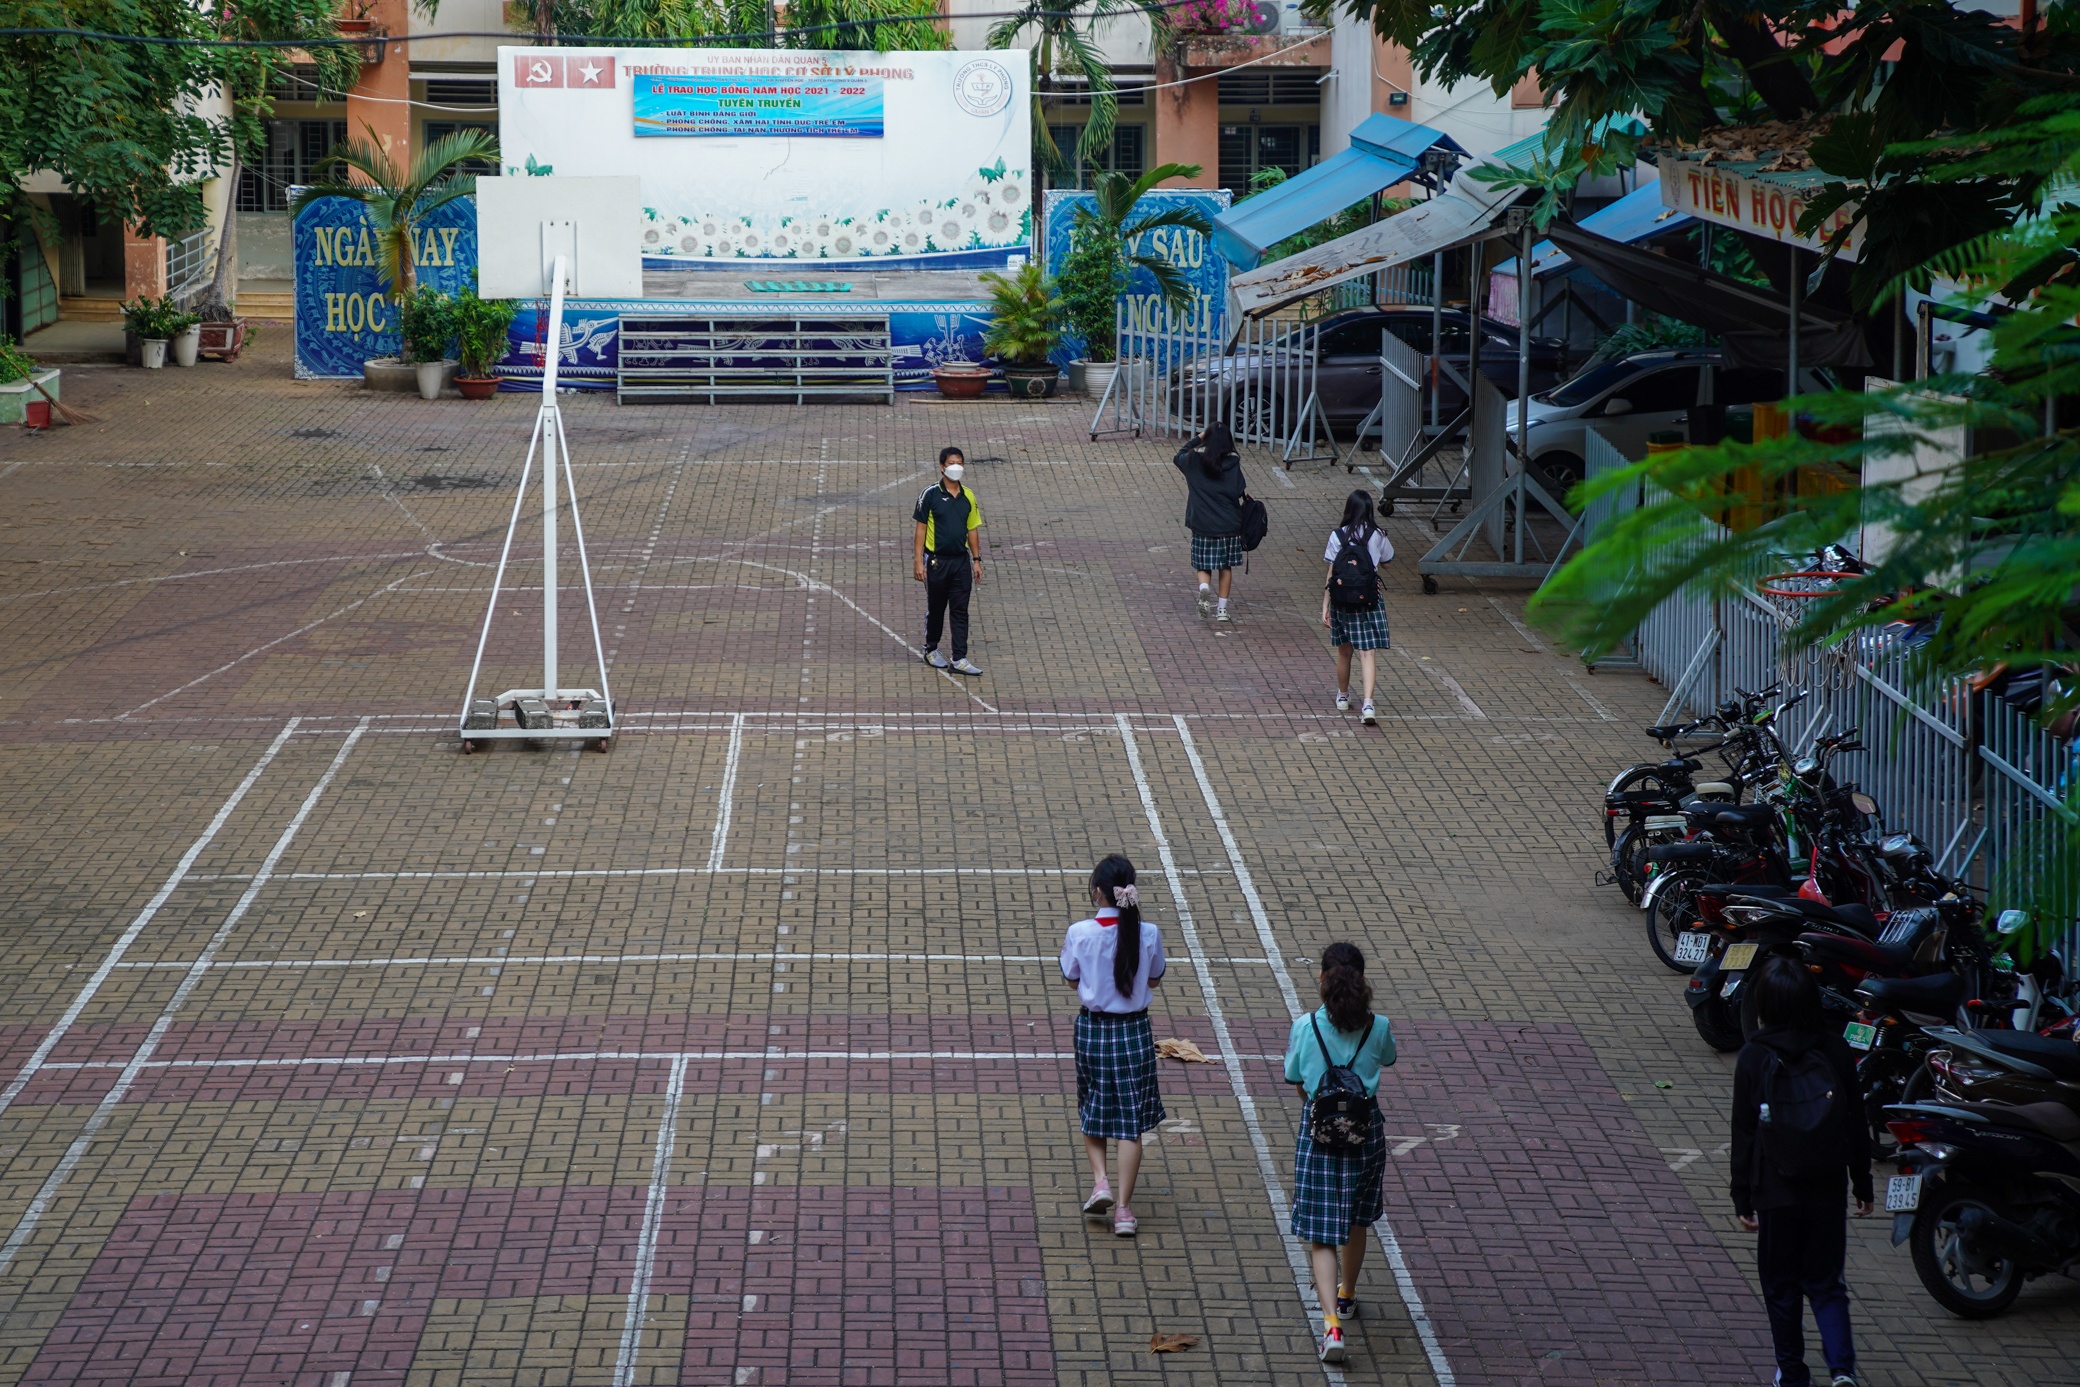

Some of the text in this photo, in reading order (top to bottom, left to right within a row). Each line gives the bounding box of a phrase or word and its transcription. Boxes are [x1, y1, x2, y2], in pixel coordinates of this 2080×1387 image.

[722, 56, 741, 64] BAN
[860, 67, 914, 80] PHONG
[997, 69, 1010, 90] PHONG
[667, 86, 693, 94] TRAO
[696, 86, 717, 96] HỌC
[780, 87, 801, 95] HỌC
[840, 87, 865, 95] 2022
[717, 98, 754, 107] TUYÊN
[1687, 168, 1741, 223] TIÊN
[1152, 228, 1204, 269] SAU
[325, 292, 386, 342] HỌC
[1678, 947, 1705, 960] 324.27
[1887, 1193, 1917, 1209] 239.45
